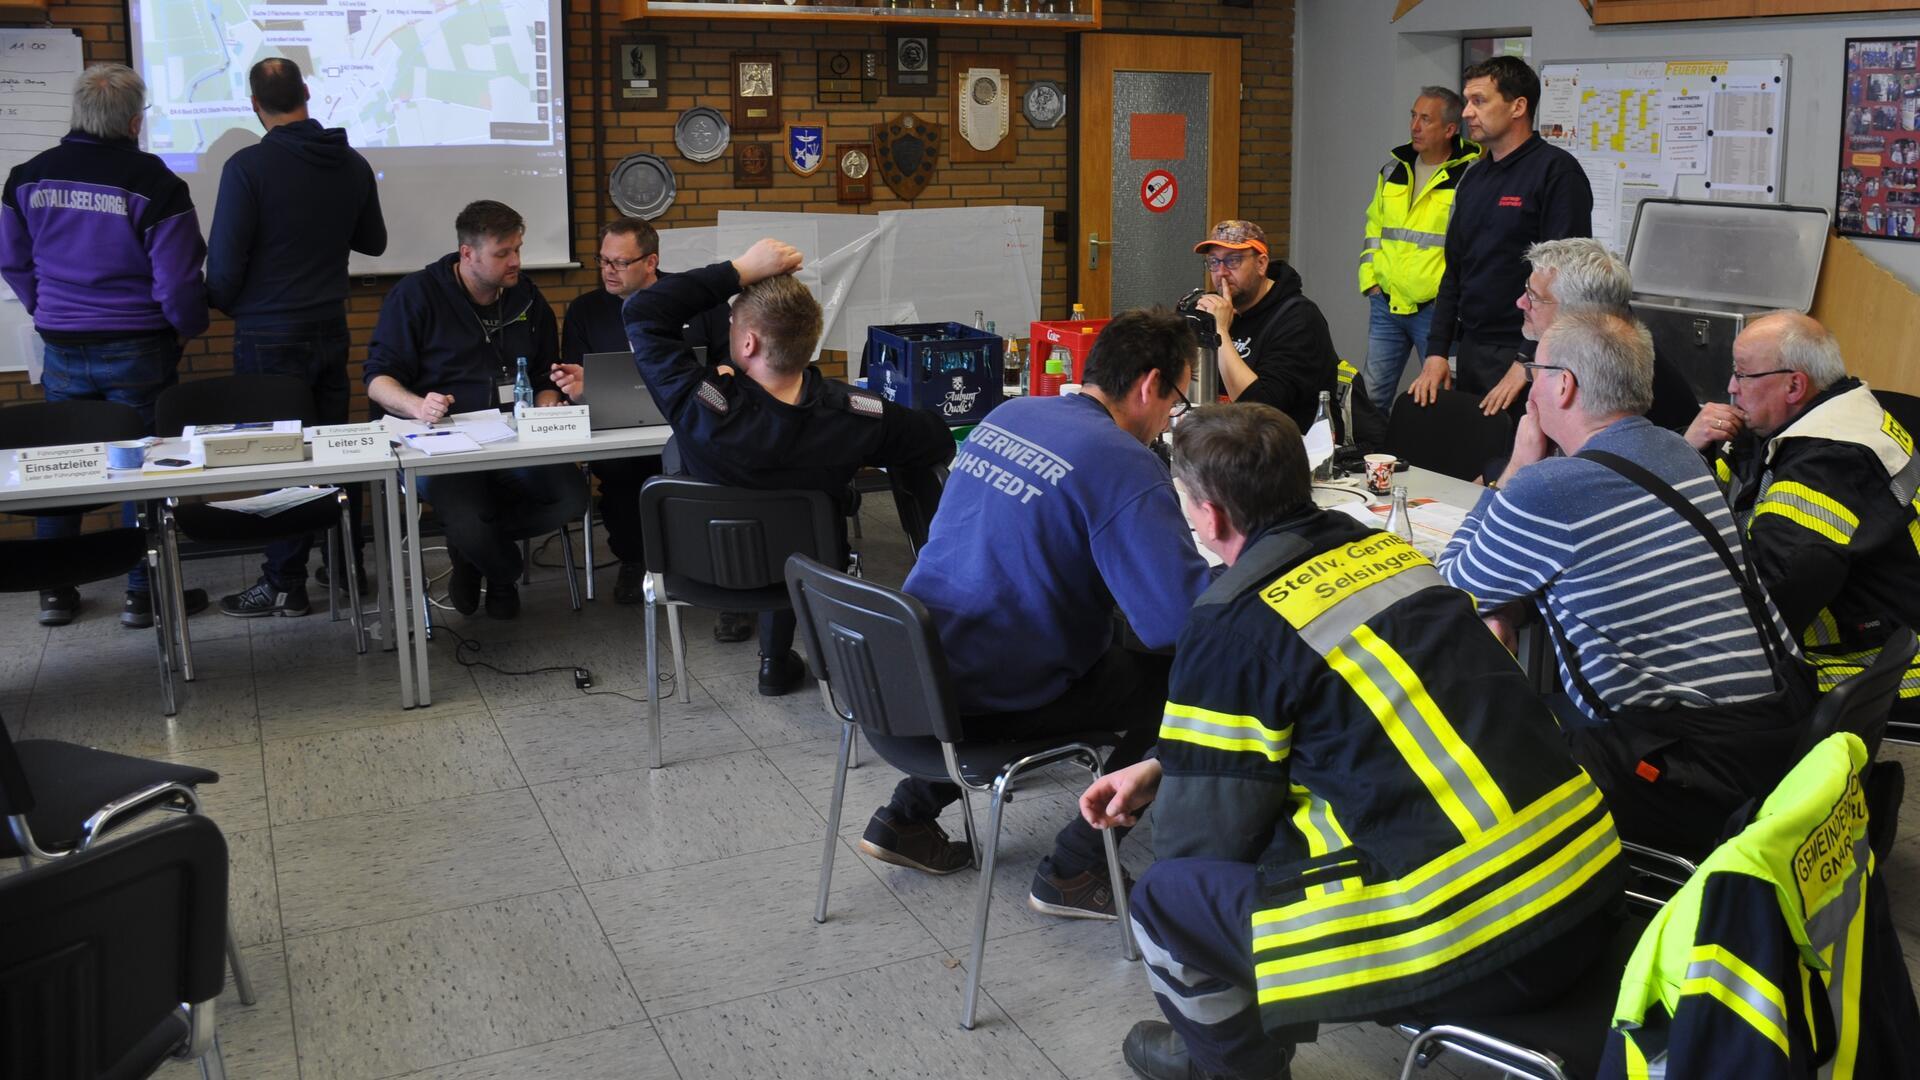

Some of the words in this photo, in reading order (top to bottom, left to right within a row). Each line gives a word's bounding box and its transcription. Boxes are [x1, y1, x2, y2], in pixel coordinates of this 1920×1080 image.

[531, 423, 577, 433] Lagekarte
[328, 438, 358, 448] Leiter
[361, 437, 374, 446] S3
[25, 459, 99, 474] Einsatzleiter
[1267, 558, 1345, 604] Stellv.
[1314, 549, 1421, 600] Selsingen
